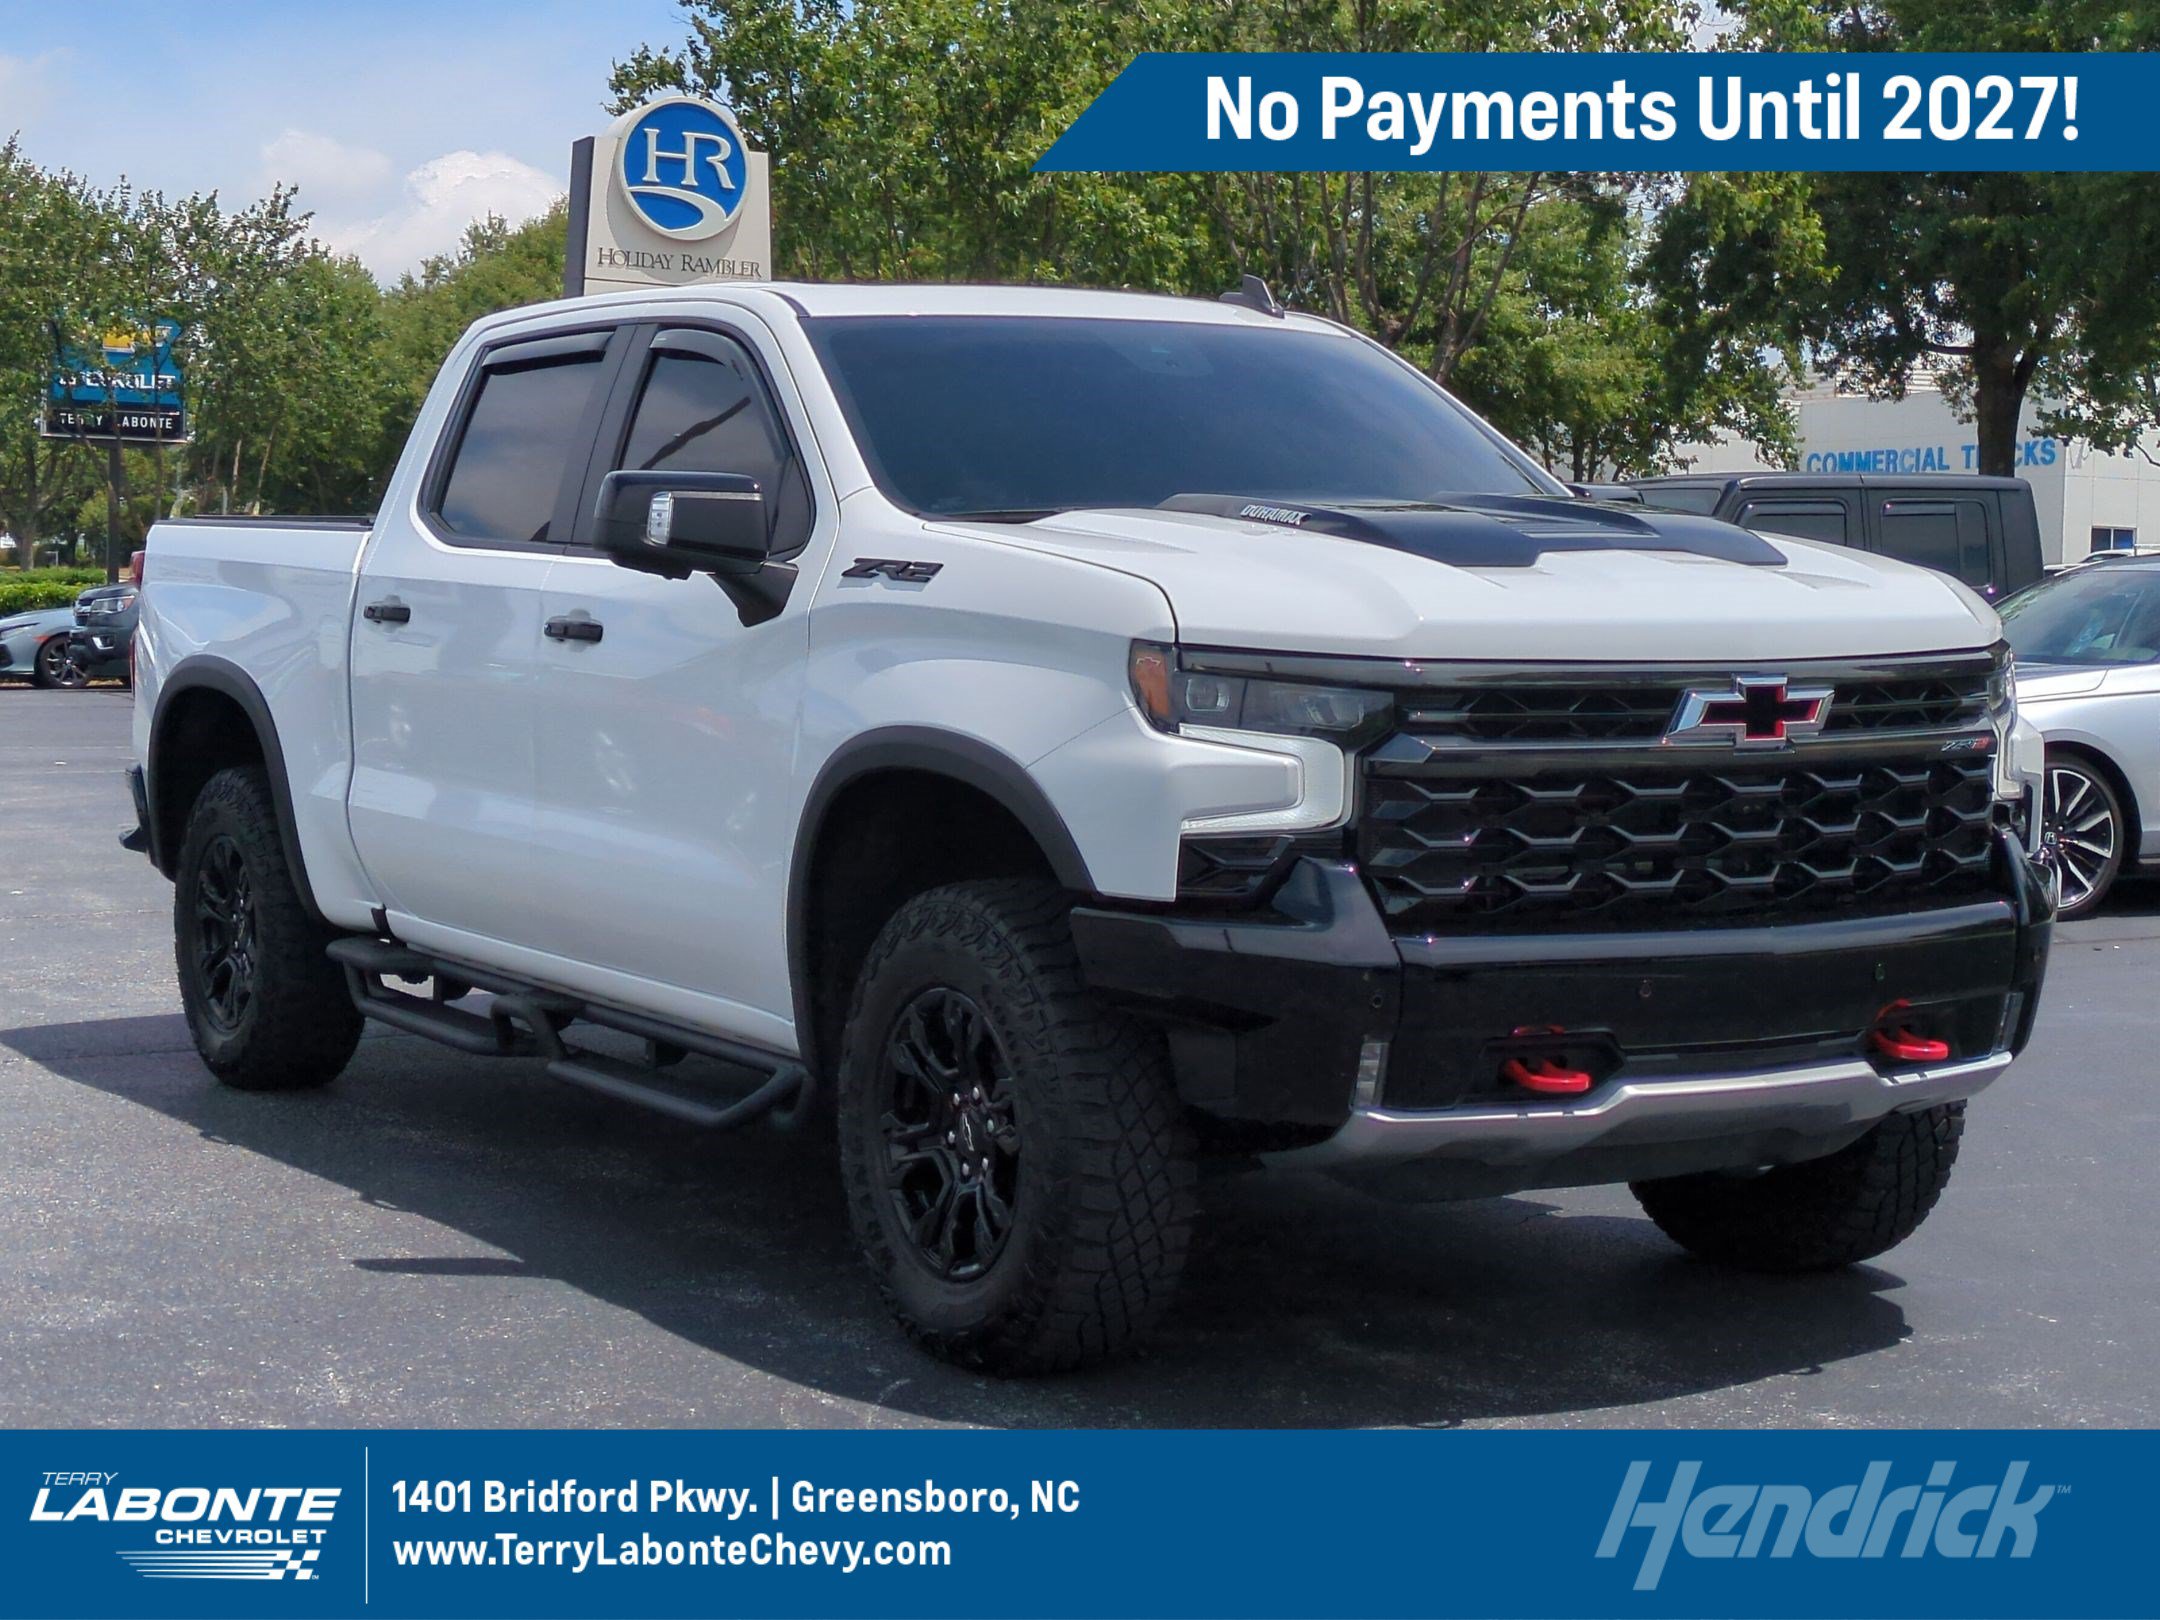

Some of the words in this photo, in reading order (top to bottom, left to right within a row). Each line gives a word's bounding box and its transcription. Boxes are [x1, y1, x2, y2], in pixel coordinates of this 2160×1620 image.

[642, 128, 735, 189] HR
[597, 247, 673, 270] HOLIDAY
[681, 254, 762, 278] RAMBLER
[59, 370, 176, 389] EROLET
[117, 415, 173, 429] ABONTE
[1806, 446, 1950, 473] COMMERCIAL
[1961, 438, 2056, 470] TCKS
[841, 557, 944, 584] ZR2
